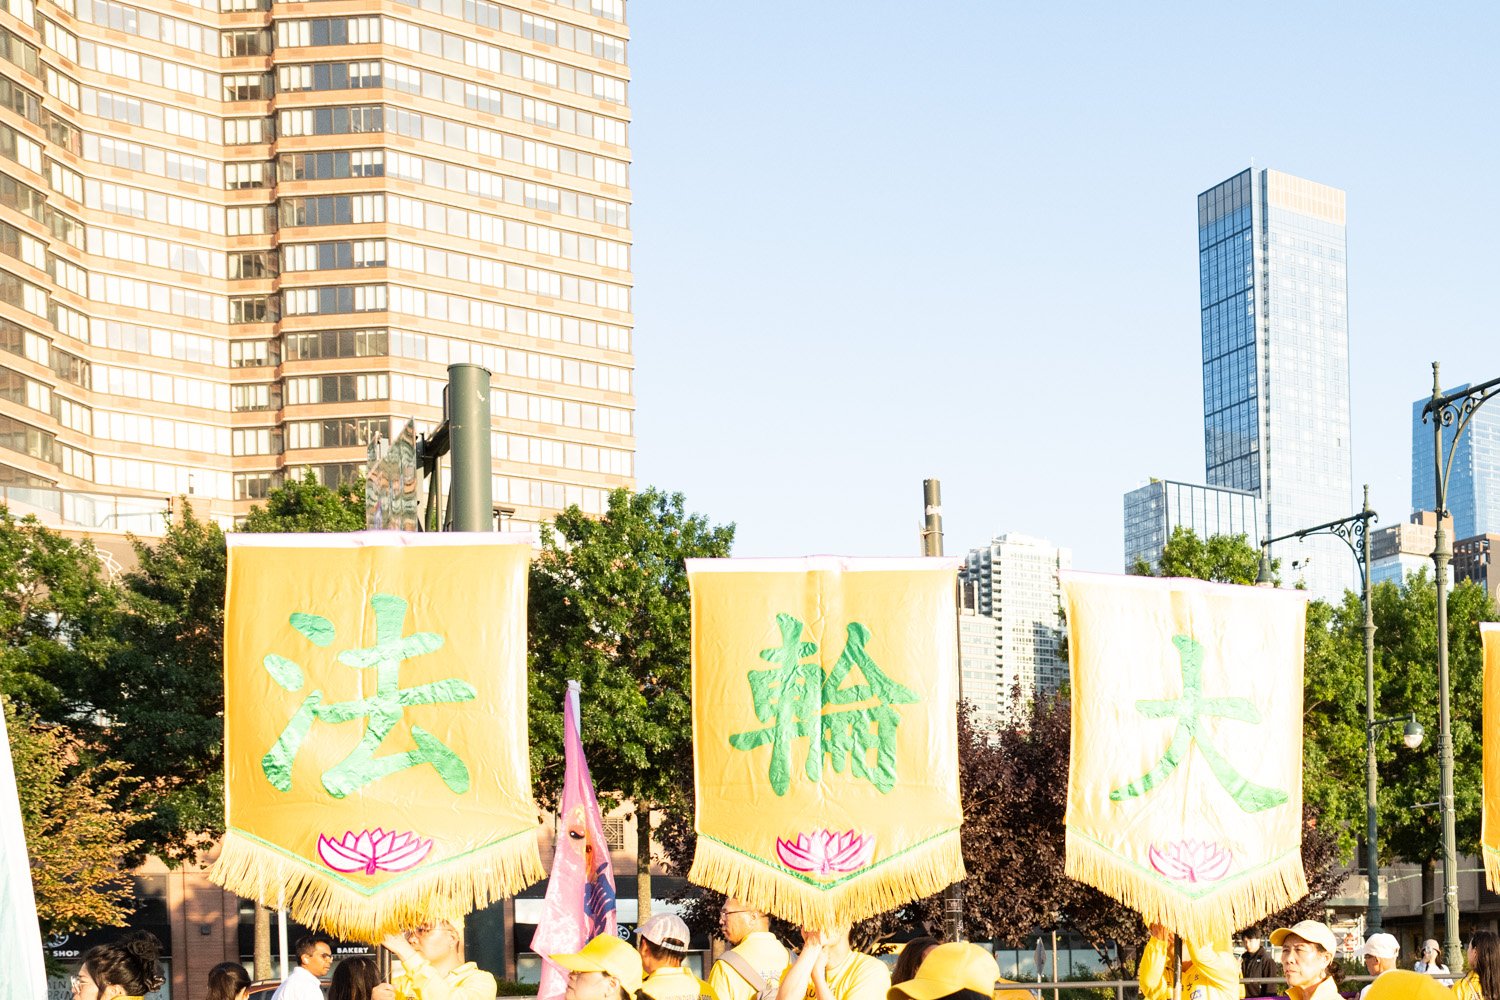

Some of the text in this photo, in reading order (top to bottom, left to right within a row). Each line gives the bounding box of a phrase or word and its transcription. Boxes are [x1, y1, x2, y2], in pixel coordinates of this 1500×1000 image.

[261, 592, 478, 799] 法
[728, 613, 922, 797] 輪
[1109, 634, 1288, 813] 大
